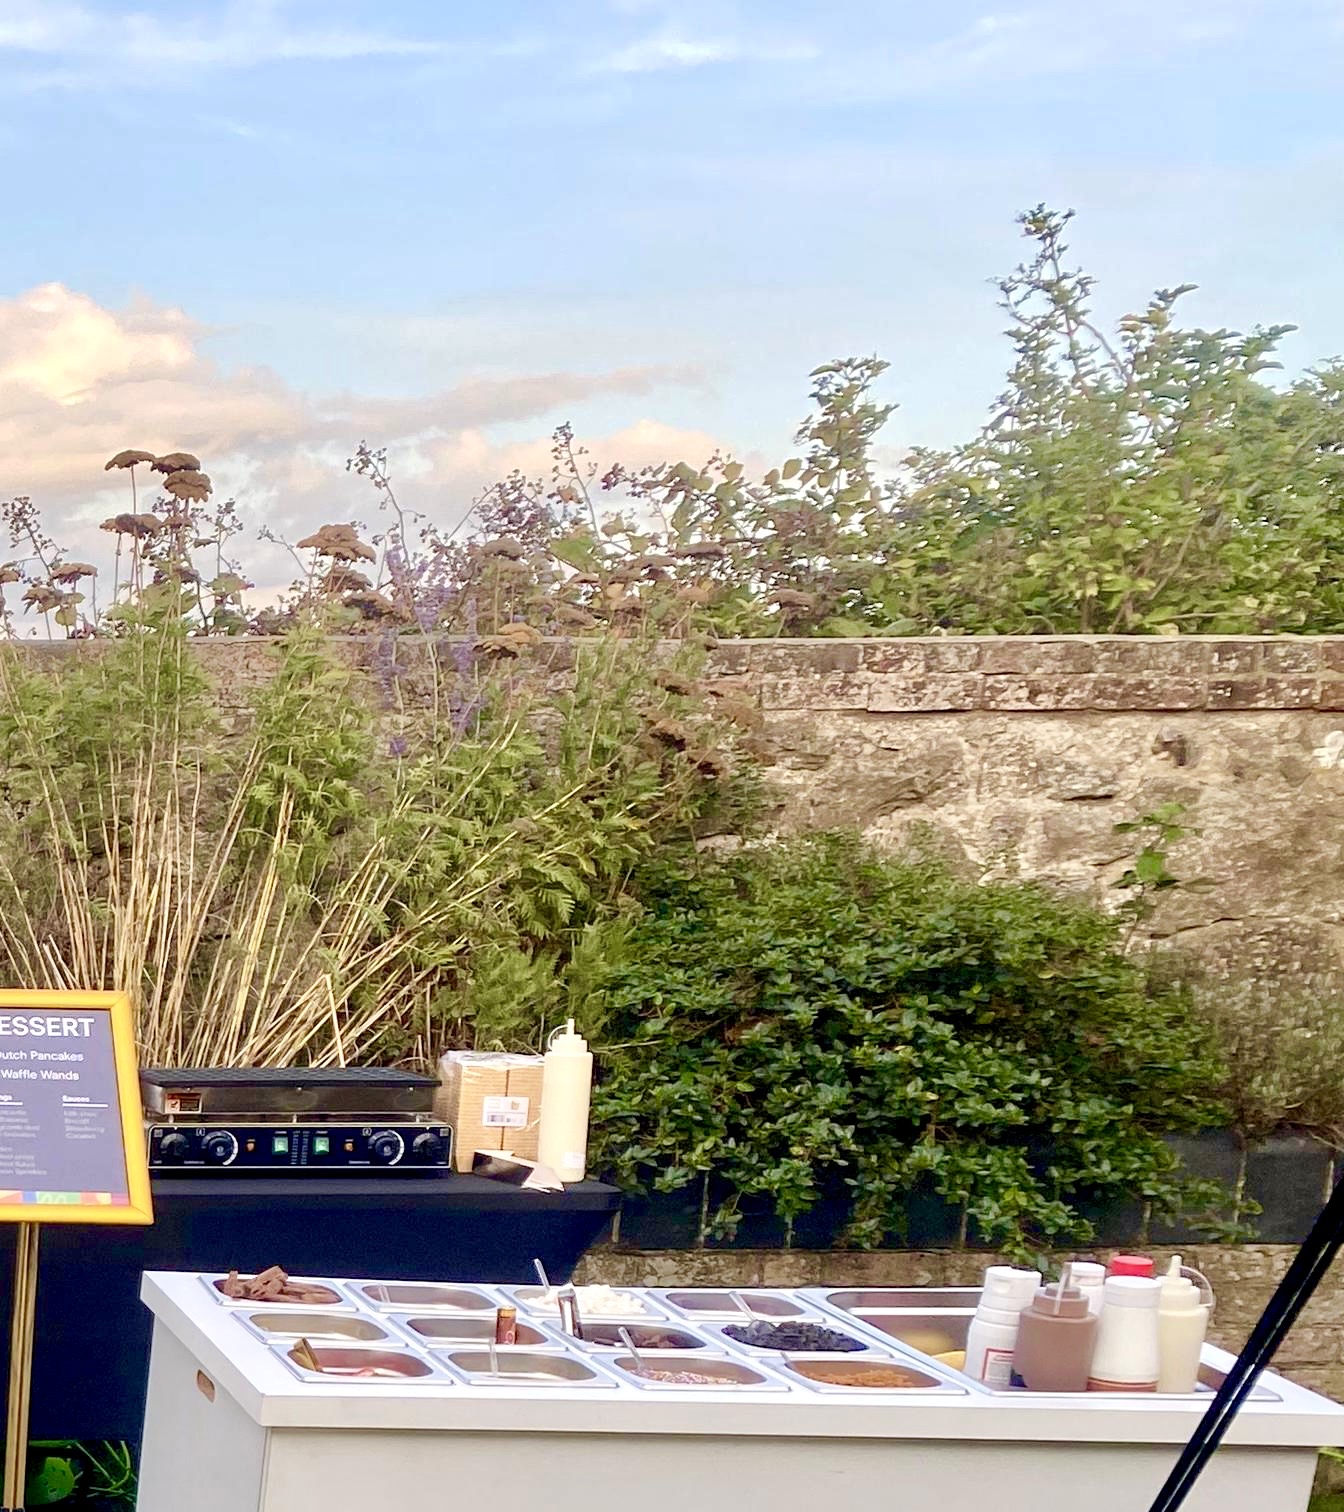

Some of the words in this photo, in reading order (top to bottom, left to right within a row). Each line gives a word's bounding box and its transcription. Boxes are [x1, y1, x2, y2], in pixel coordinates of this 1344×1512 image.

[30, 1050, 85, 1062] Pancakes
[0, 1068, 39, 1080] Waffle
[40, 1069, 81, 1081] Wands
